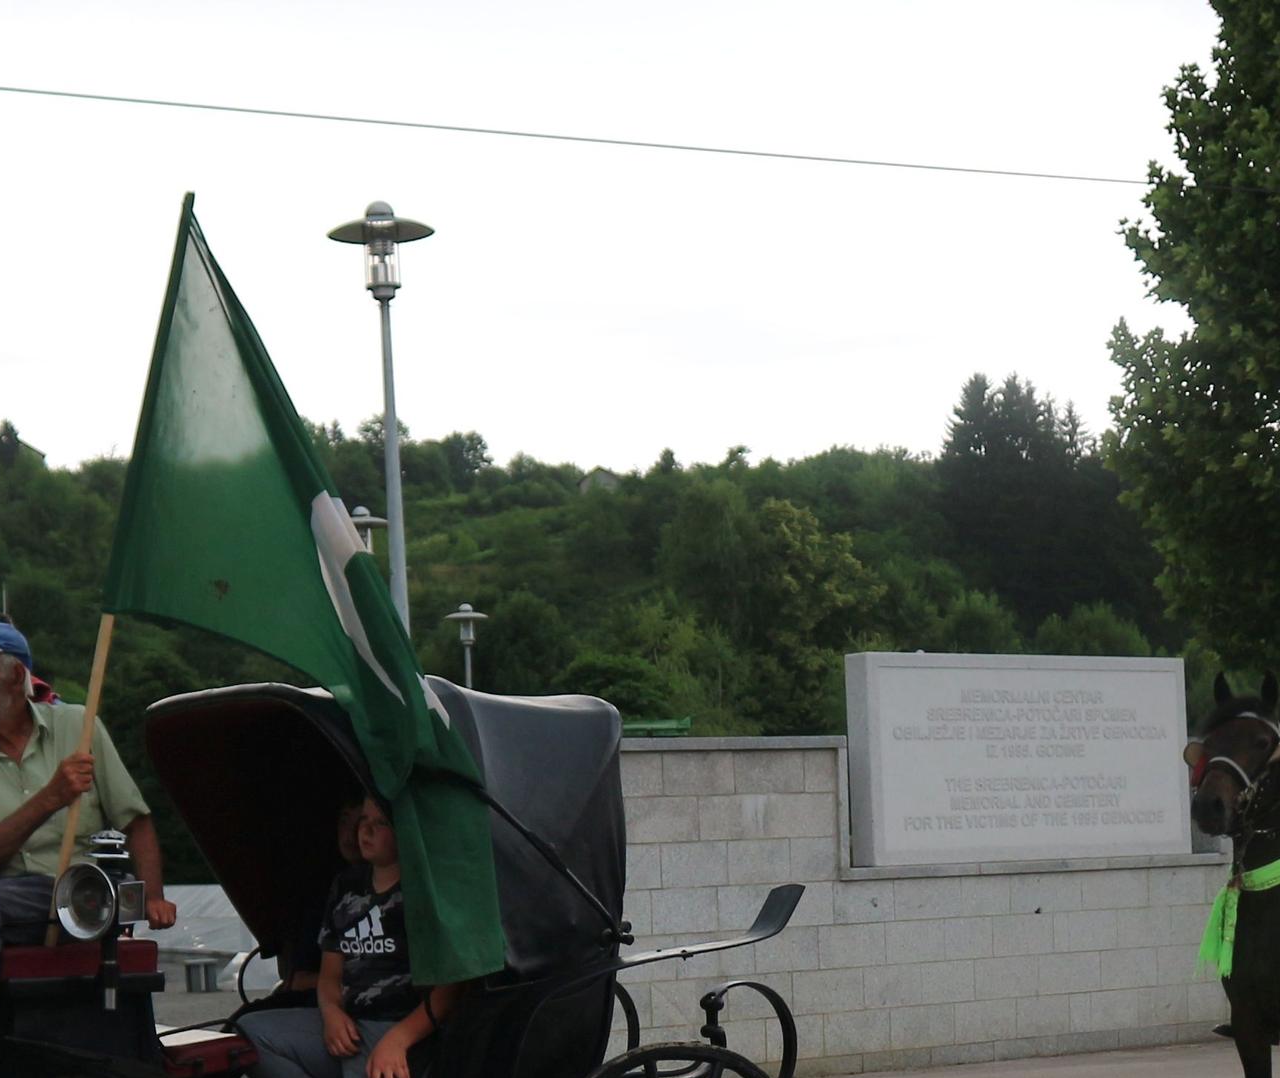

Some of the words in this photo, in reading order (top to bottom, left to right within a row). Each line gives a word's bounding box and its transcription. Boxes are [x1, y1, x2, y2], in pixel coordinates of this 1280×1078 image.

[1053, 689, 1104, 704] CENTAR
[1085, 708, 1137, 721] SPOMEN
[1102, 726, 1167, 740] GENOCIDA
[1035, 744, 1086, 758] GODINE
[944, 777, 971, 792] THE
[950, 796, 1020, 810] MEMORIAL
[1023, 794, 1051, 808] AND
[1054, 793, 1120, 808] CEMETERY
[904, 816, 933, 831] FOR
[935, 815, 963, 830] THE
[964, 814, 1018, 829] VICTIMS
[1020, 813, 1038, 827] OF
[1040, 813, 1068, 827] THE
[1100, 810, 1166, 825] GENOCIDE
[340, 936, 396, 953] adidas
